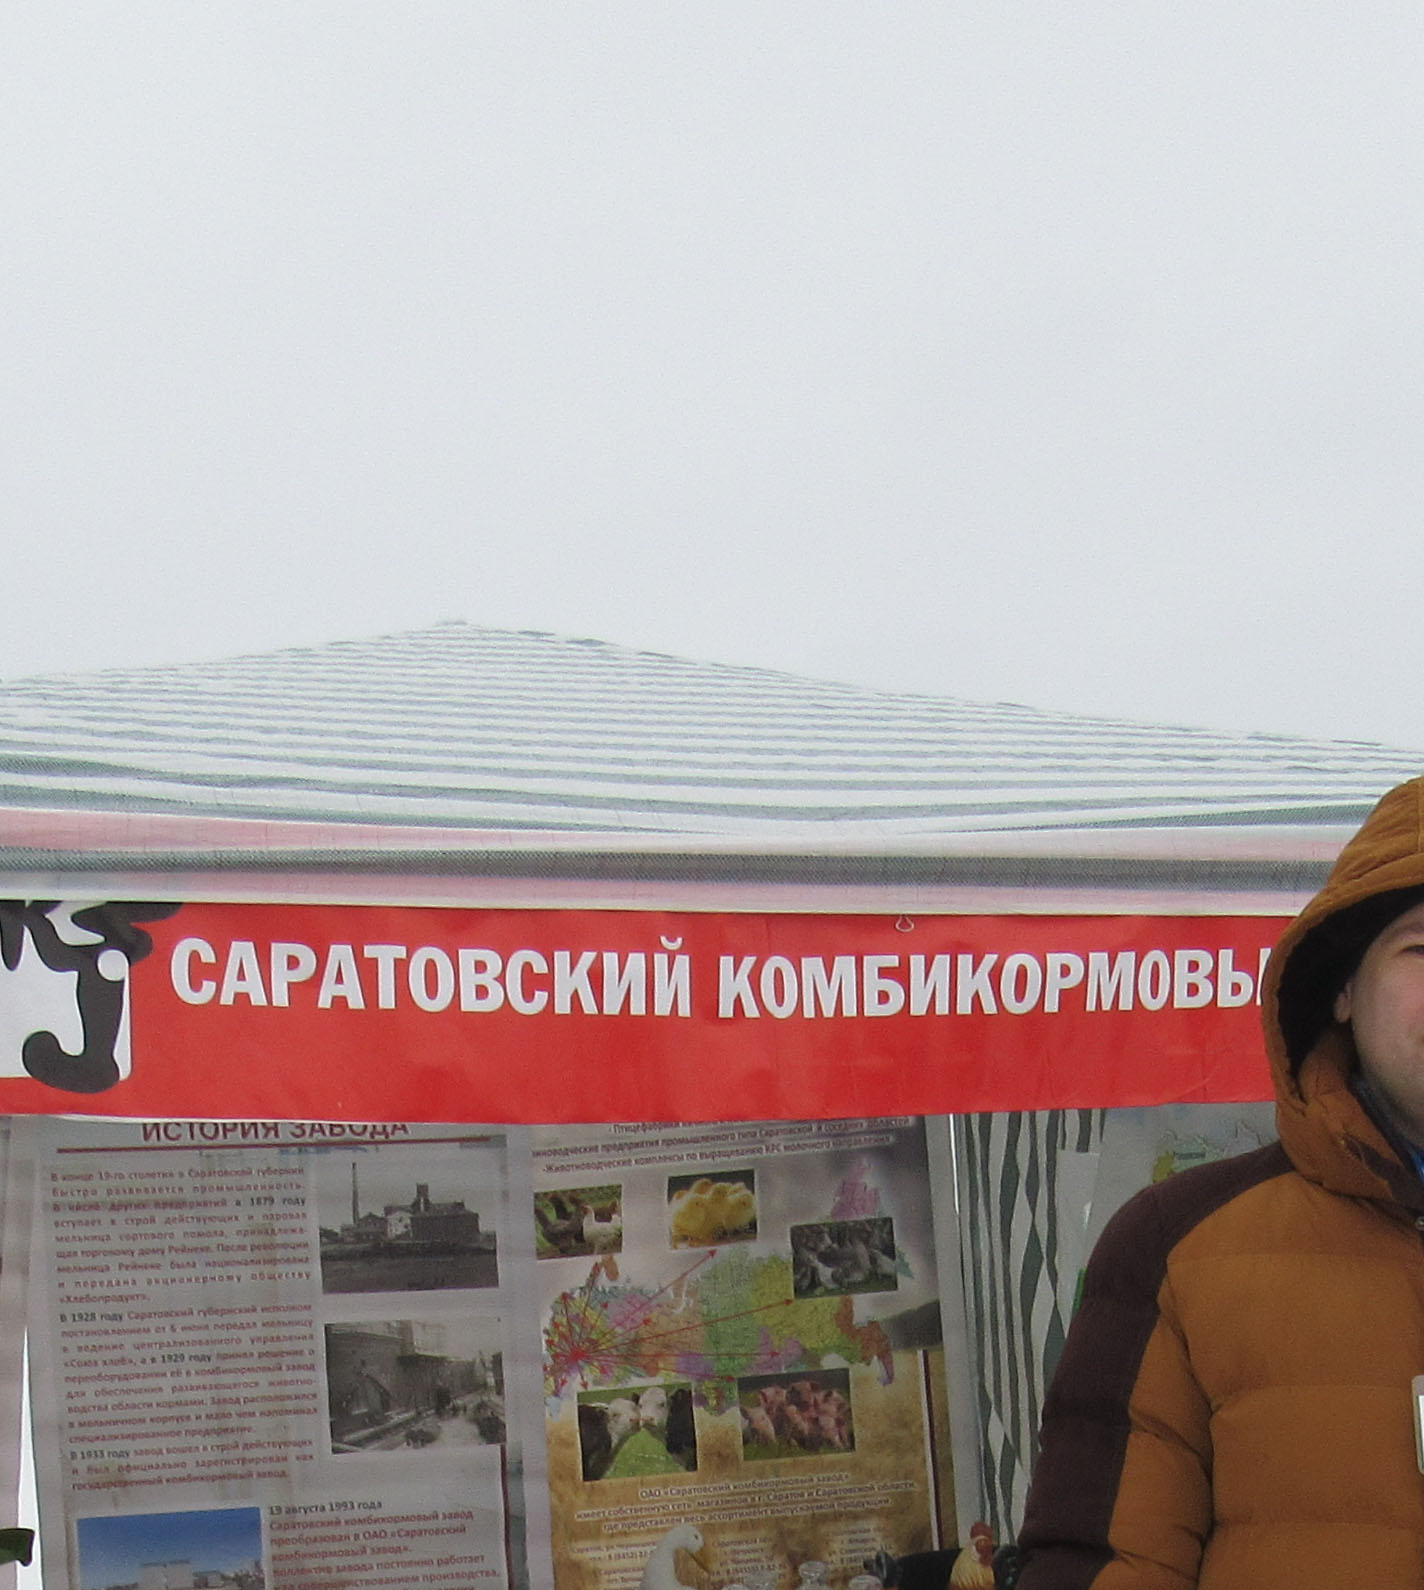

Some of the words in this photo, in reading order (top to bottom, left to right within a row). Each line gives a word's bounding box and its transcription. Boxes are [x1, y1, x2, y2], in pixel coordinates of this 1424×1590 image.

[171, 936, 692, 1018] САРАТОВСКИЙ
[718, 947, 1272, 1019] КОМБИКОРМОВЫ
[142, 1123, 280, 1142] ИСТОРИЯ
[288, 1122, 410, 1140] ЗАВОДА
